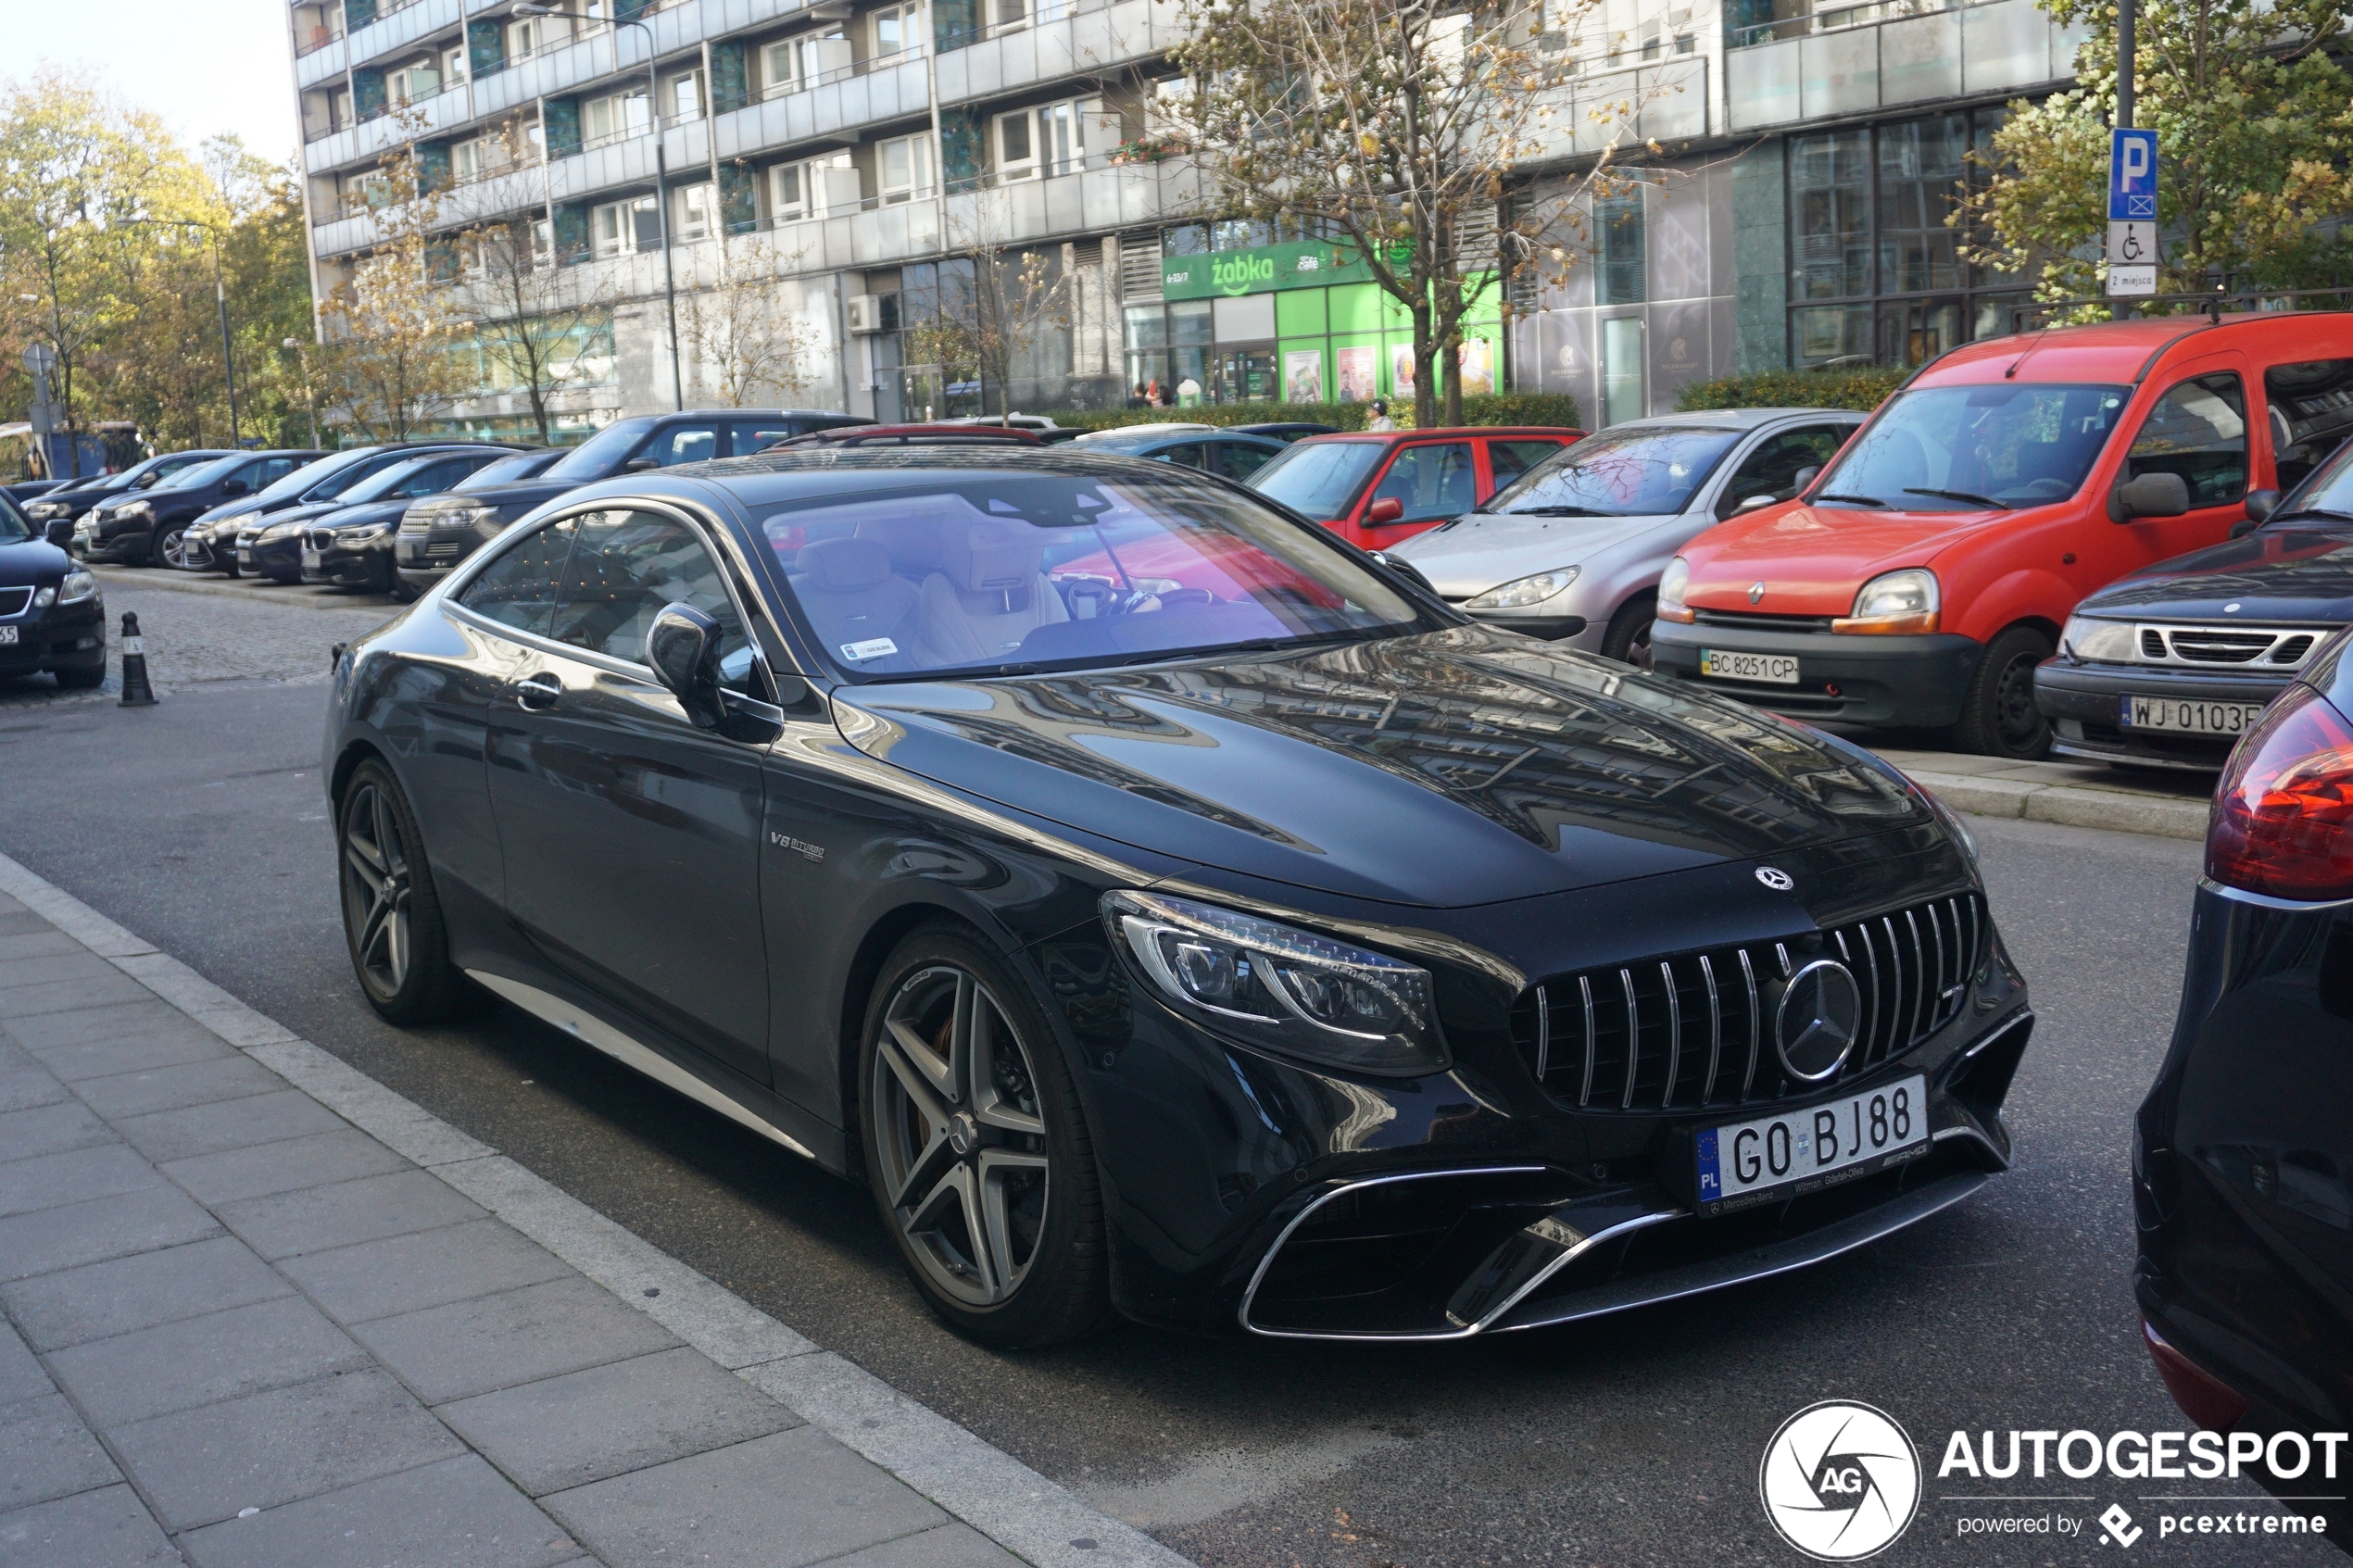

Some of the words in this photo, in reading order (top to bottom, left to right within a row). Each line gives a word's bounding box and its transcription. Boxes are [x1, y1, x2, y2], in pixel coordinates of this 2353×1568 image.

[2121, 137, 2148, 193] P
[1212, 255, 1274, 284] żabka
[1298, 256, 1319, 270] café
[1166, 272, 1189, 283] 6-23/7
[2112, 275, 2118, 285] 2
[2121, 274, 2152, 287] miejsca
[1710, 653, 1730, 672] BC
[1734, 656, 1768, 677] 8251
[1771, 659, 1794, 679] CP
[2135, 699, 2166, 726] WJ
[771, 831, 791, 848] V8
[791, 837, 824, 856] BITURBO
[1814, 1086, 1911, 1167] BJ88
[1896, 1144, 1927, 1161] AMG
[1701, 1173, 1718, 1190] PL
[1794, 1179, 1822, 1193] Witman
[1723, 1192, 1774, 1210] Mercedes-Benz
